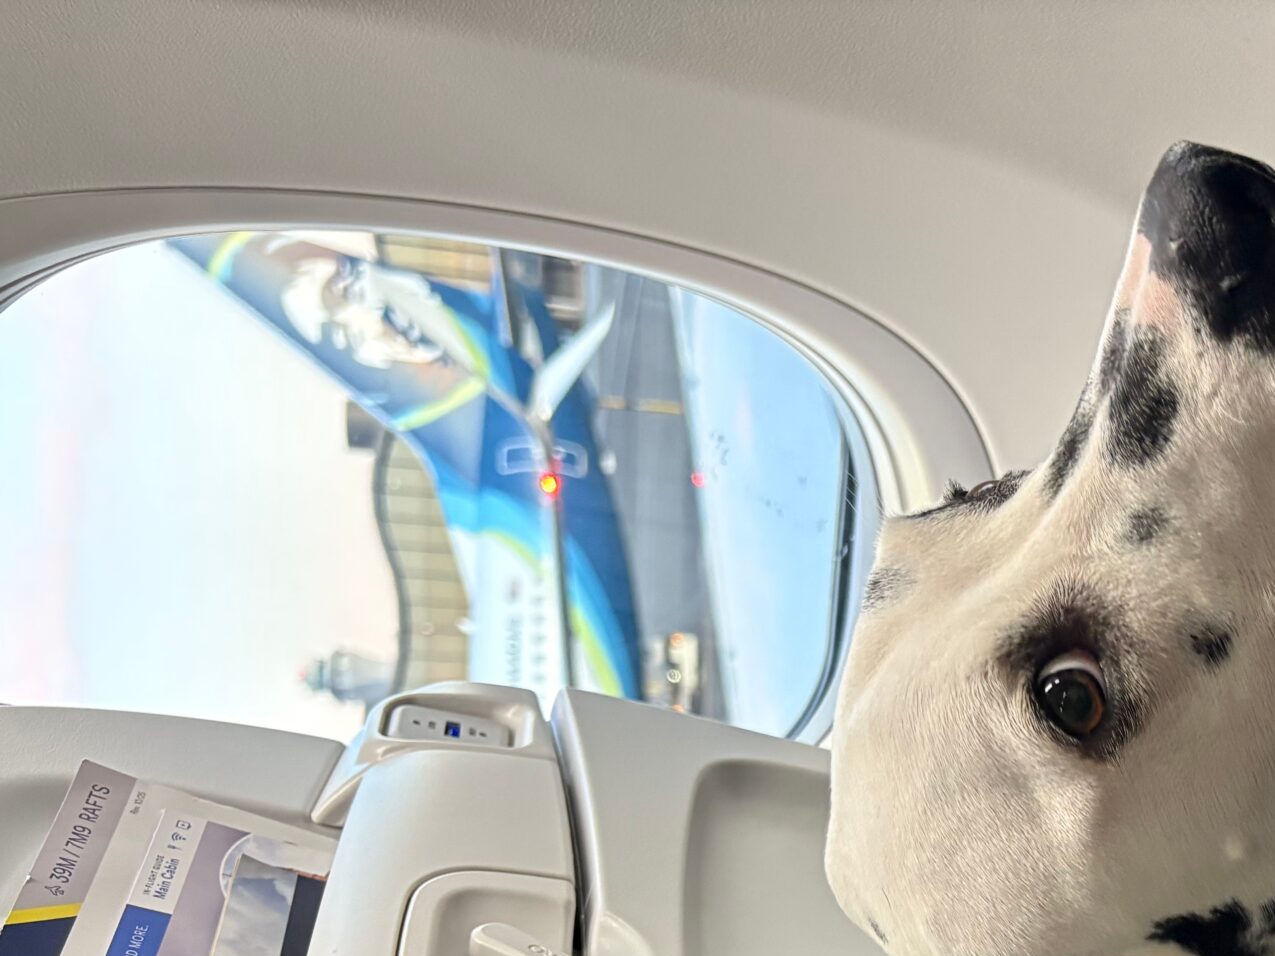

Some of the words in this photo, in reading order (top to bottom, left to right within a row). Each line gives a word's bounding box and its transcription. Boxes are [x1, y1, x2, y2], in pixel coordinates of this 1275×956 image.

[49, 856, 78, 884] 39M
[65, 825, 92, 850] 7M9
[79, 784, 110, 823] RAFTS
[143, 869, 159, 895] IN-FLIGHT
[153, 855, 165, 871] GUIDE
[161, 858, 179, 879] Cabin
[153, 876, 171, 900] Main
